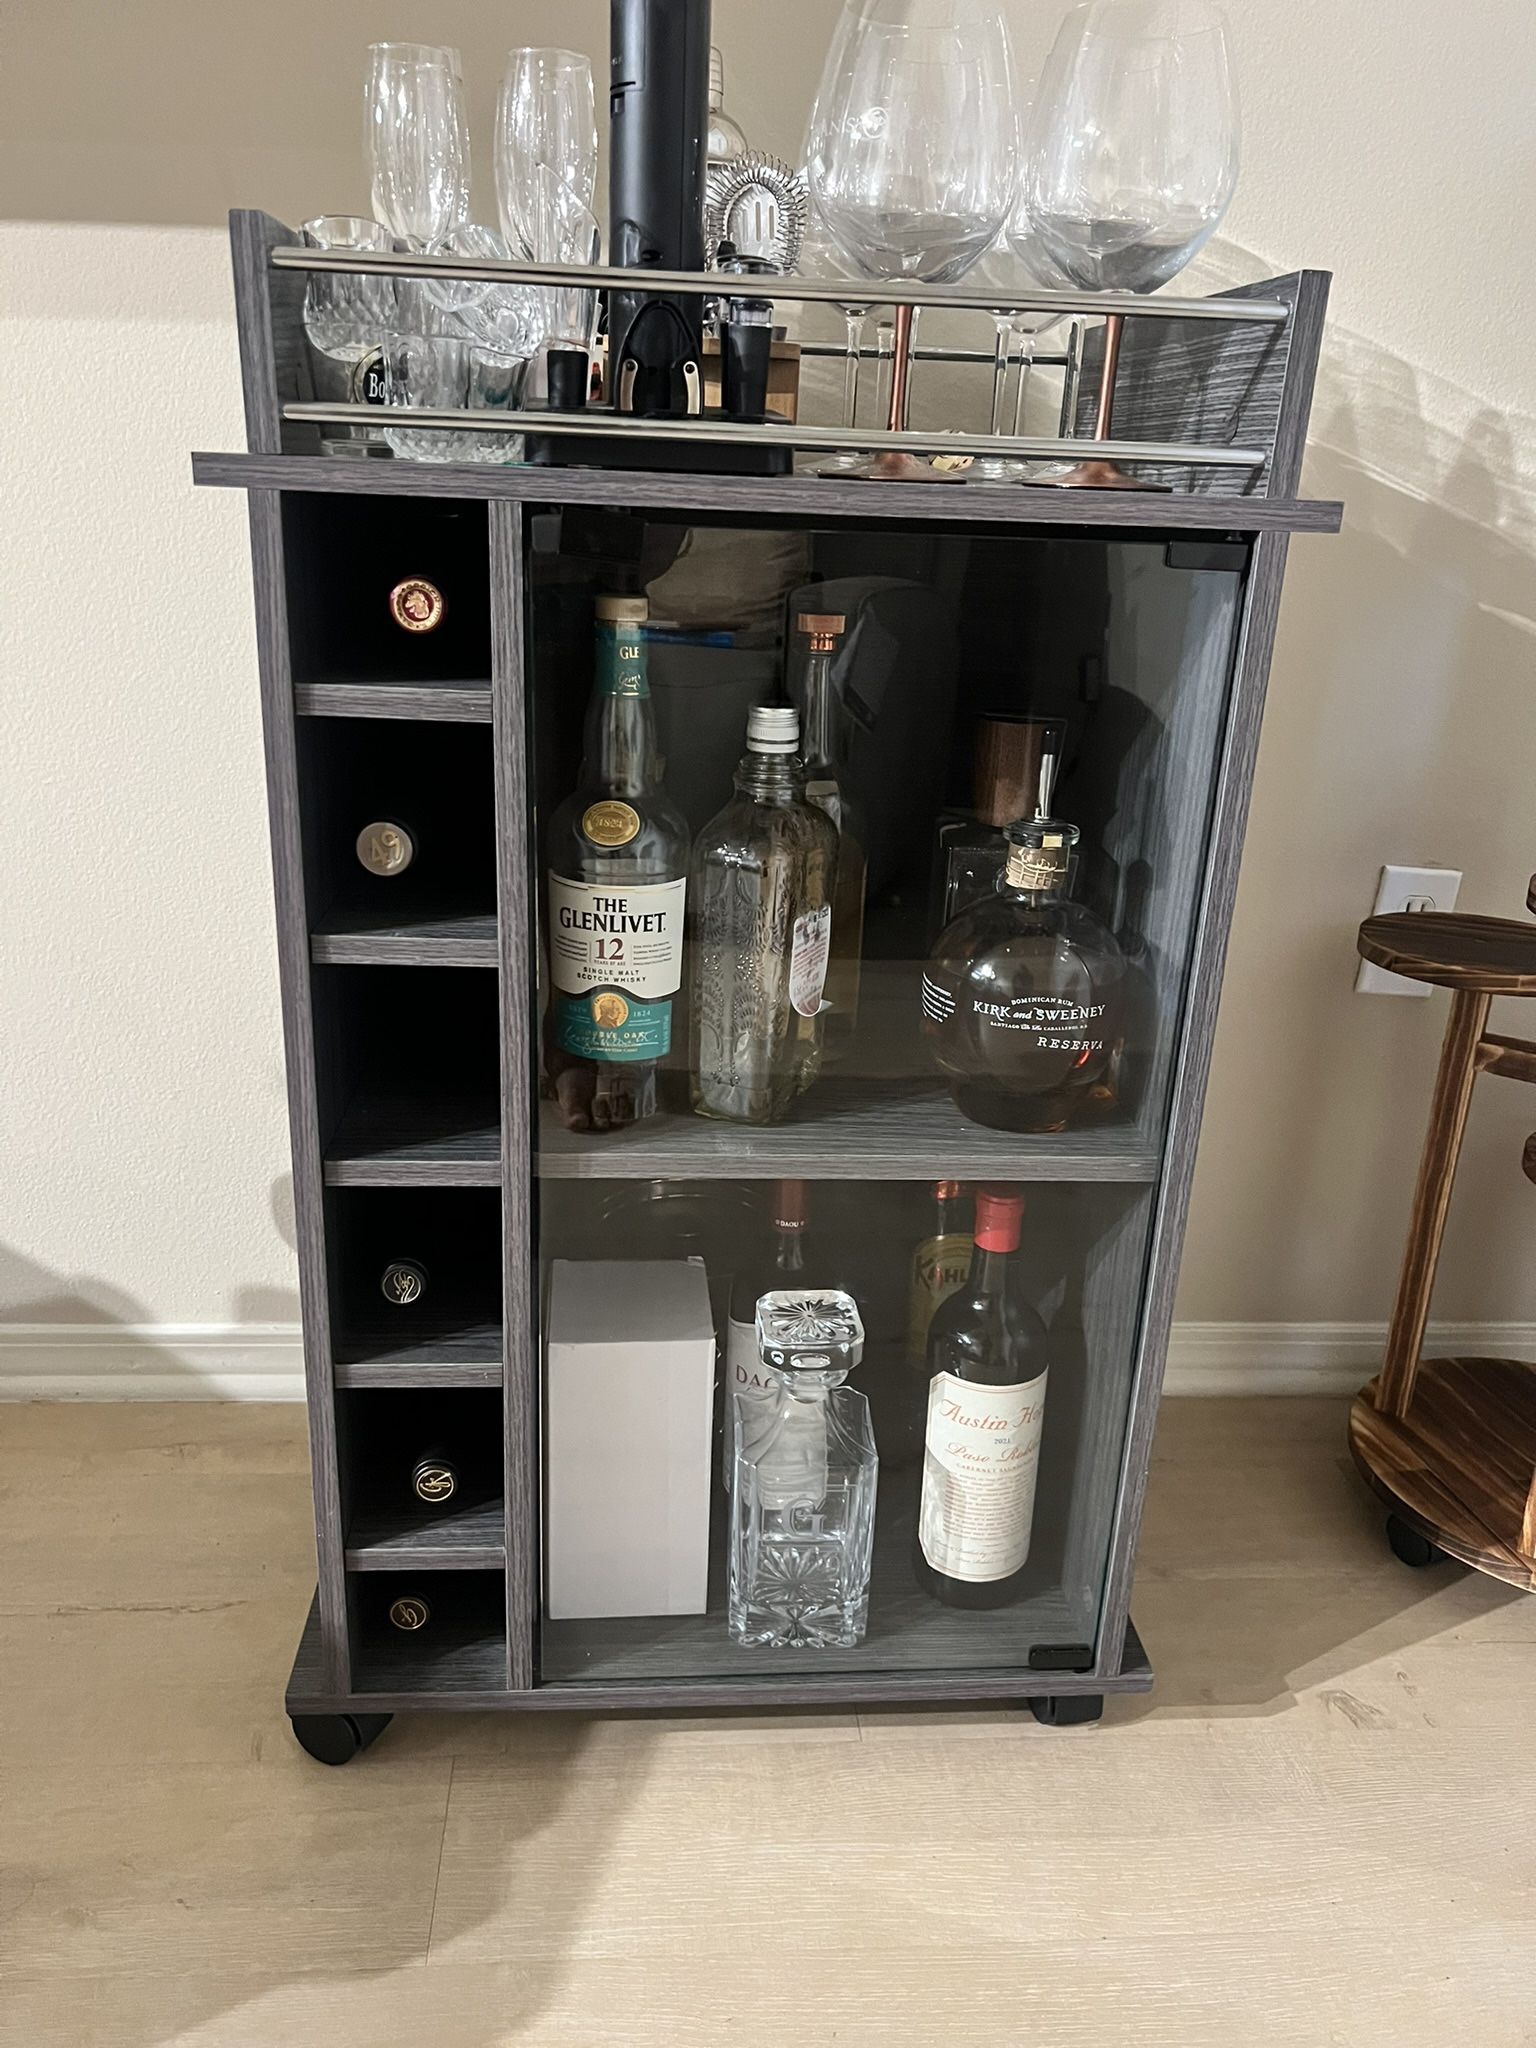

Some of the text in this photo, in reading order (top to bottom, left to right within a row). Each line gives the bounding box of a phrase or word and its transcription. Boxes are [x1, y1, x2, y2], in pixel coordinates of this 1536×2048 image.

[592, 897, 627, 913] THE
[594, 938, 625, 961] 12
[577, 973, 609, 982] SCOTCH
[583, 966, 614, 976] SINGLE
[1011, 997, 1056, 1006] DOMINICAN
[973, 1000, 1106, 1022] KIRK and SWEENEY
[990, 1021, 1020, 1031] SANTIAGO
[1037, 1036, 1103, 1050] RESERVA
[939, 1399, 1008, 1430] Austin
